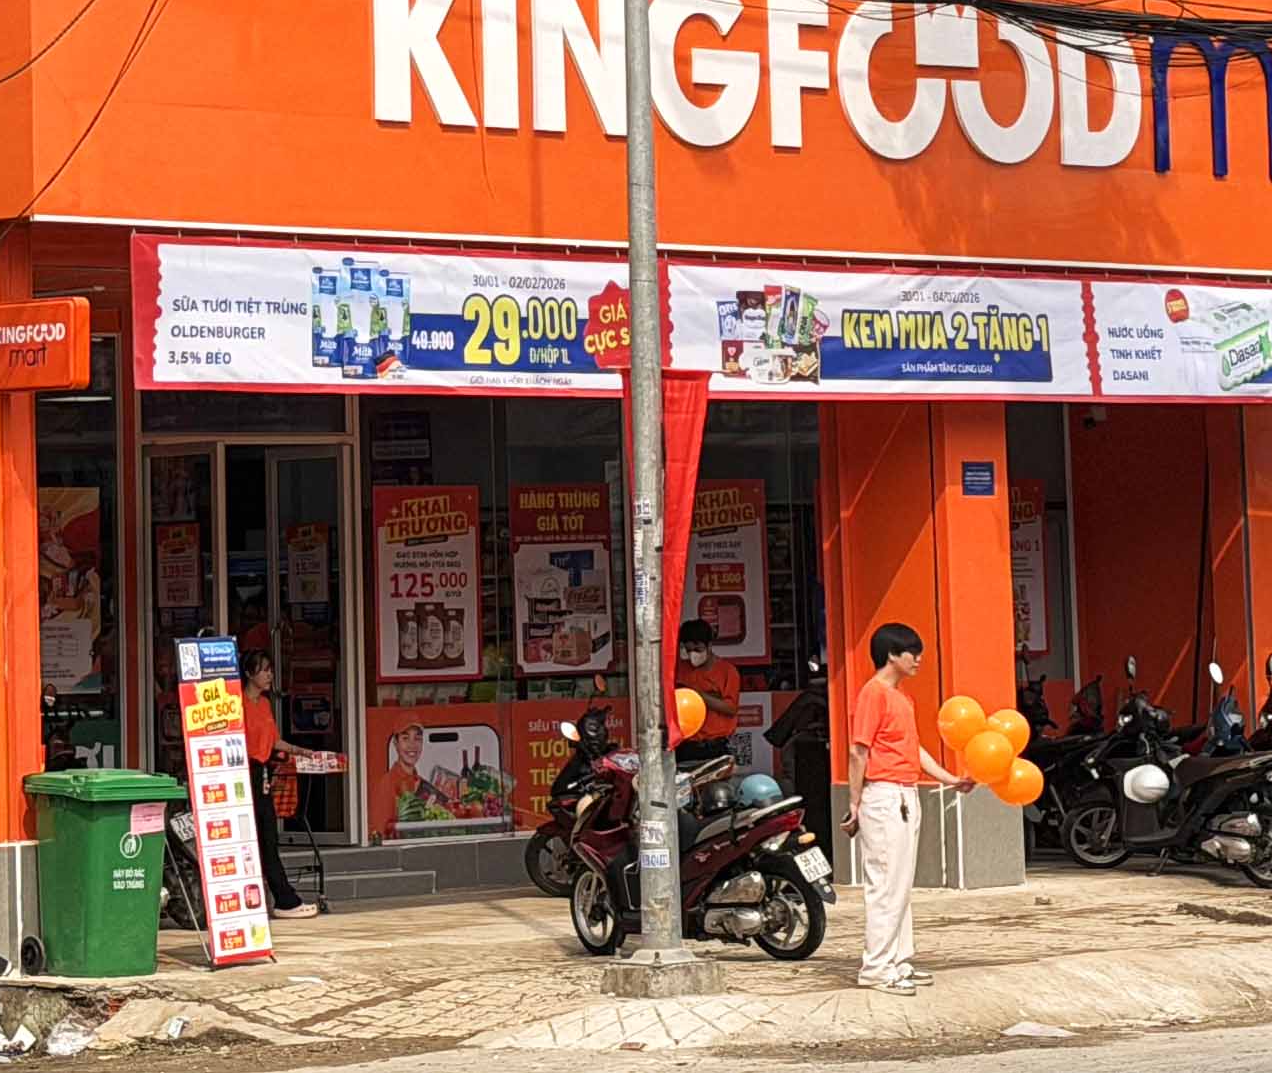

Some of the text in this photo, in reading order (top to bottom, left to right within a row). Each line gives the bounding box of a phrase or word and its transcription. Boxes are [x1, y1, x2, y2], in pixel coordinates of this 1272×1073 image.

[472, 274, 566, 290] 30/01 02/02/2026
[172, 294, 198, 312] SỮA
[202, 298, 232, 313] TƯƠI
[265, 297, 308, 316] TRÙNG
[170, 324, 265, 340] OLDENBURGER
[461, 292, 578, 366] 29.000
[842, 304, 1051, 363] KEM MUA 2 TẶNG 1
[9, 343, 47, 367] mart
[1112, 369, 1149, 381] DASANI
[403, 496, 450, 519] KHAI
[694, 504, 754, 527] RƯƠNG
[390, 571, 468, 598] 125.000
